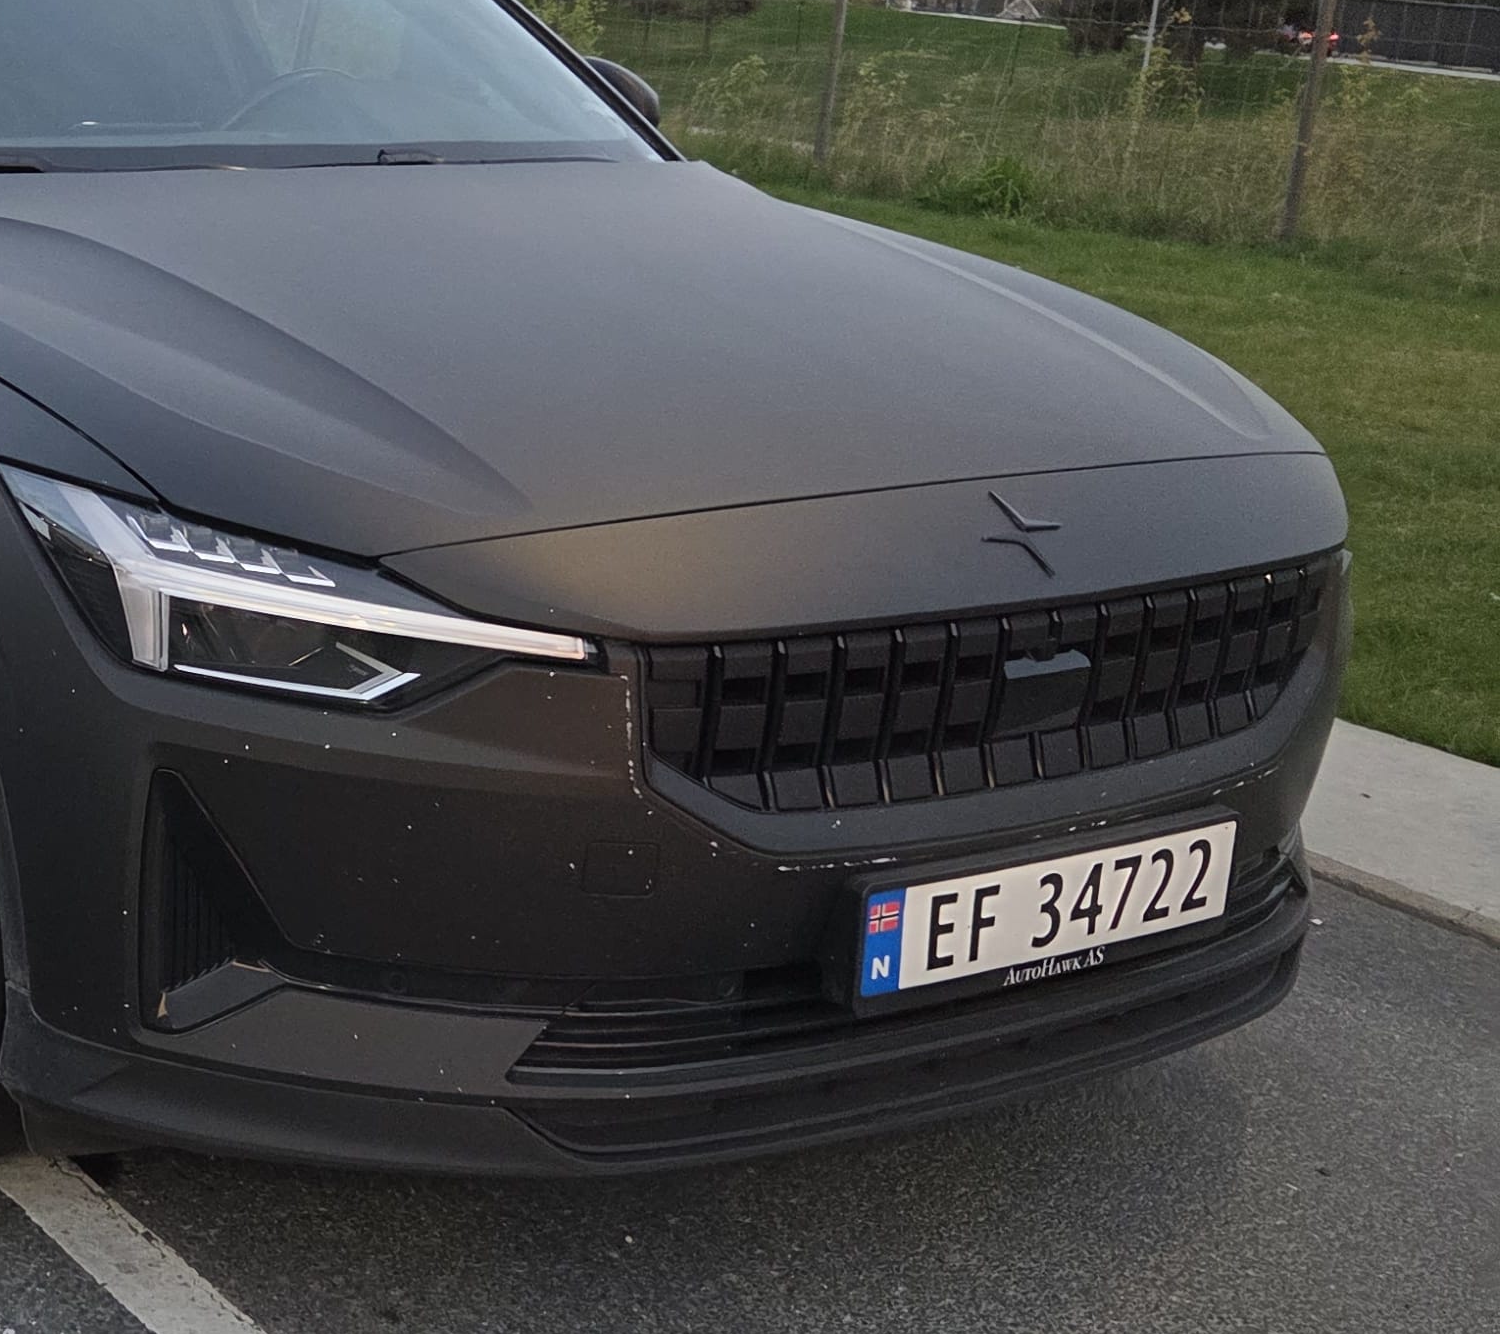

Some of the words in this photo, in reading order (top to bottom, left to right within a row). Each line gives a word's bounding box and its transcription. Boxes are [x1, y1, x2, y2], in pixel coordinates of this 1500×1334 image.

[926, 884, 1001, 971] EF
[1030, 839, 1212, 948] 34722
[870, 954, 890, 980] N
[1082, 946, 1106, 968] AS
